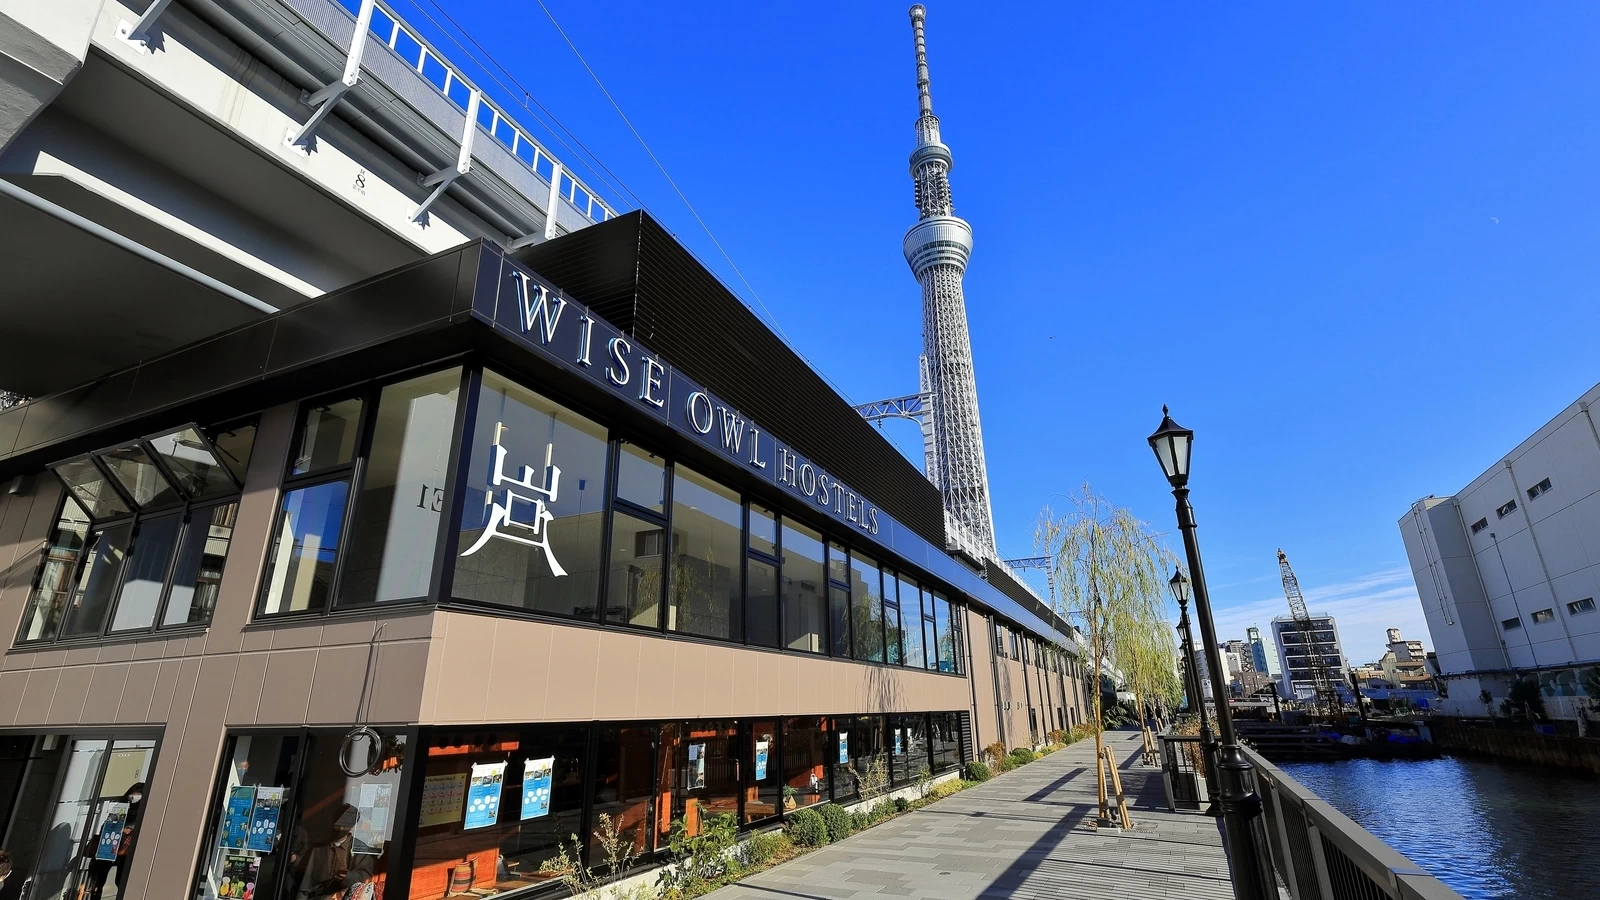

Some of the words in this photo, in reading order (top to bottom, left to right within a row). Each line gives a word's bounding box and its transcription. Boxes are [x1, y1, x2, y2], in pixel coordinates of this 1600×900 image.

[355, 174, 366, 188] 8
[512, 270, 665, 408] WISE
[685, 391, 766, 470] OWL
[778, 446, 880, 536] HOSTELS
